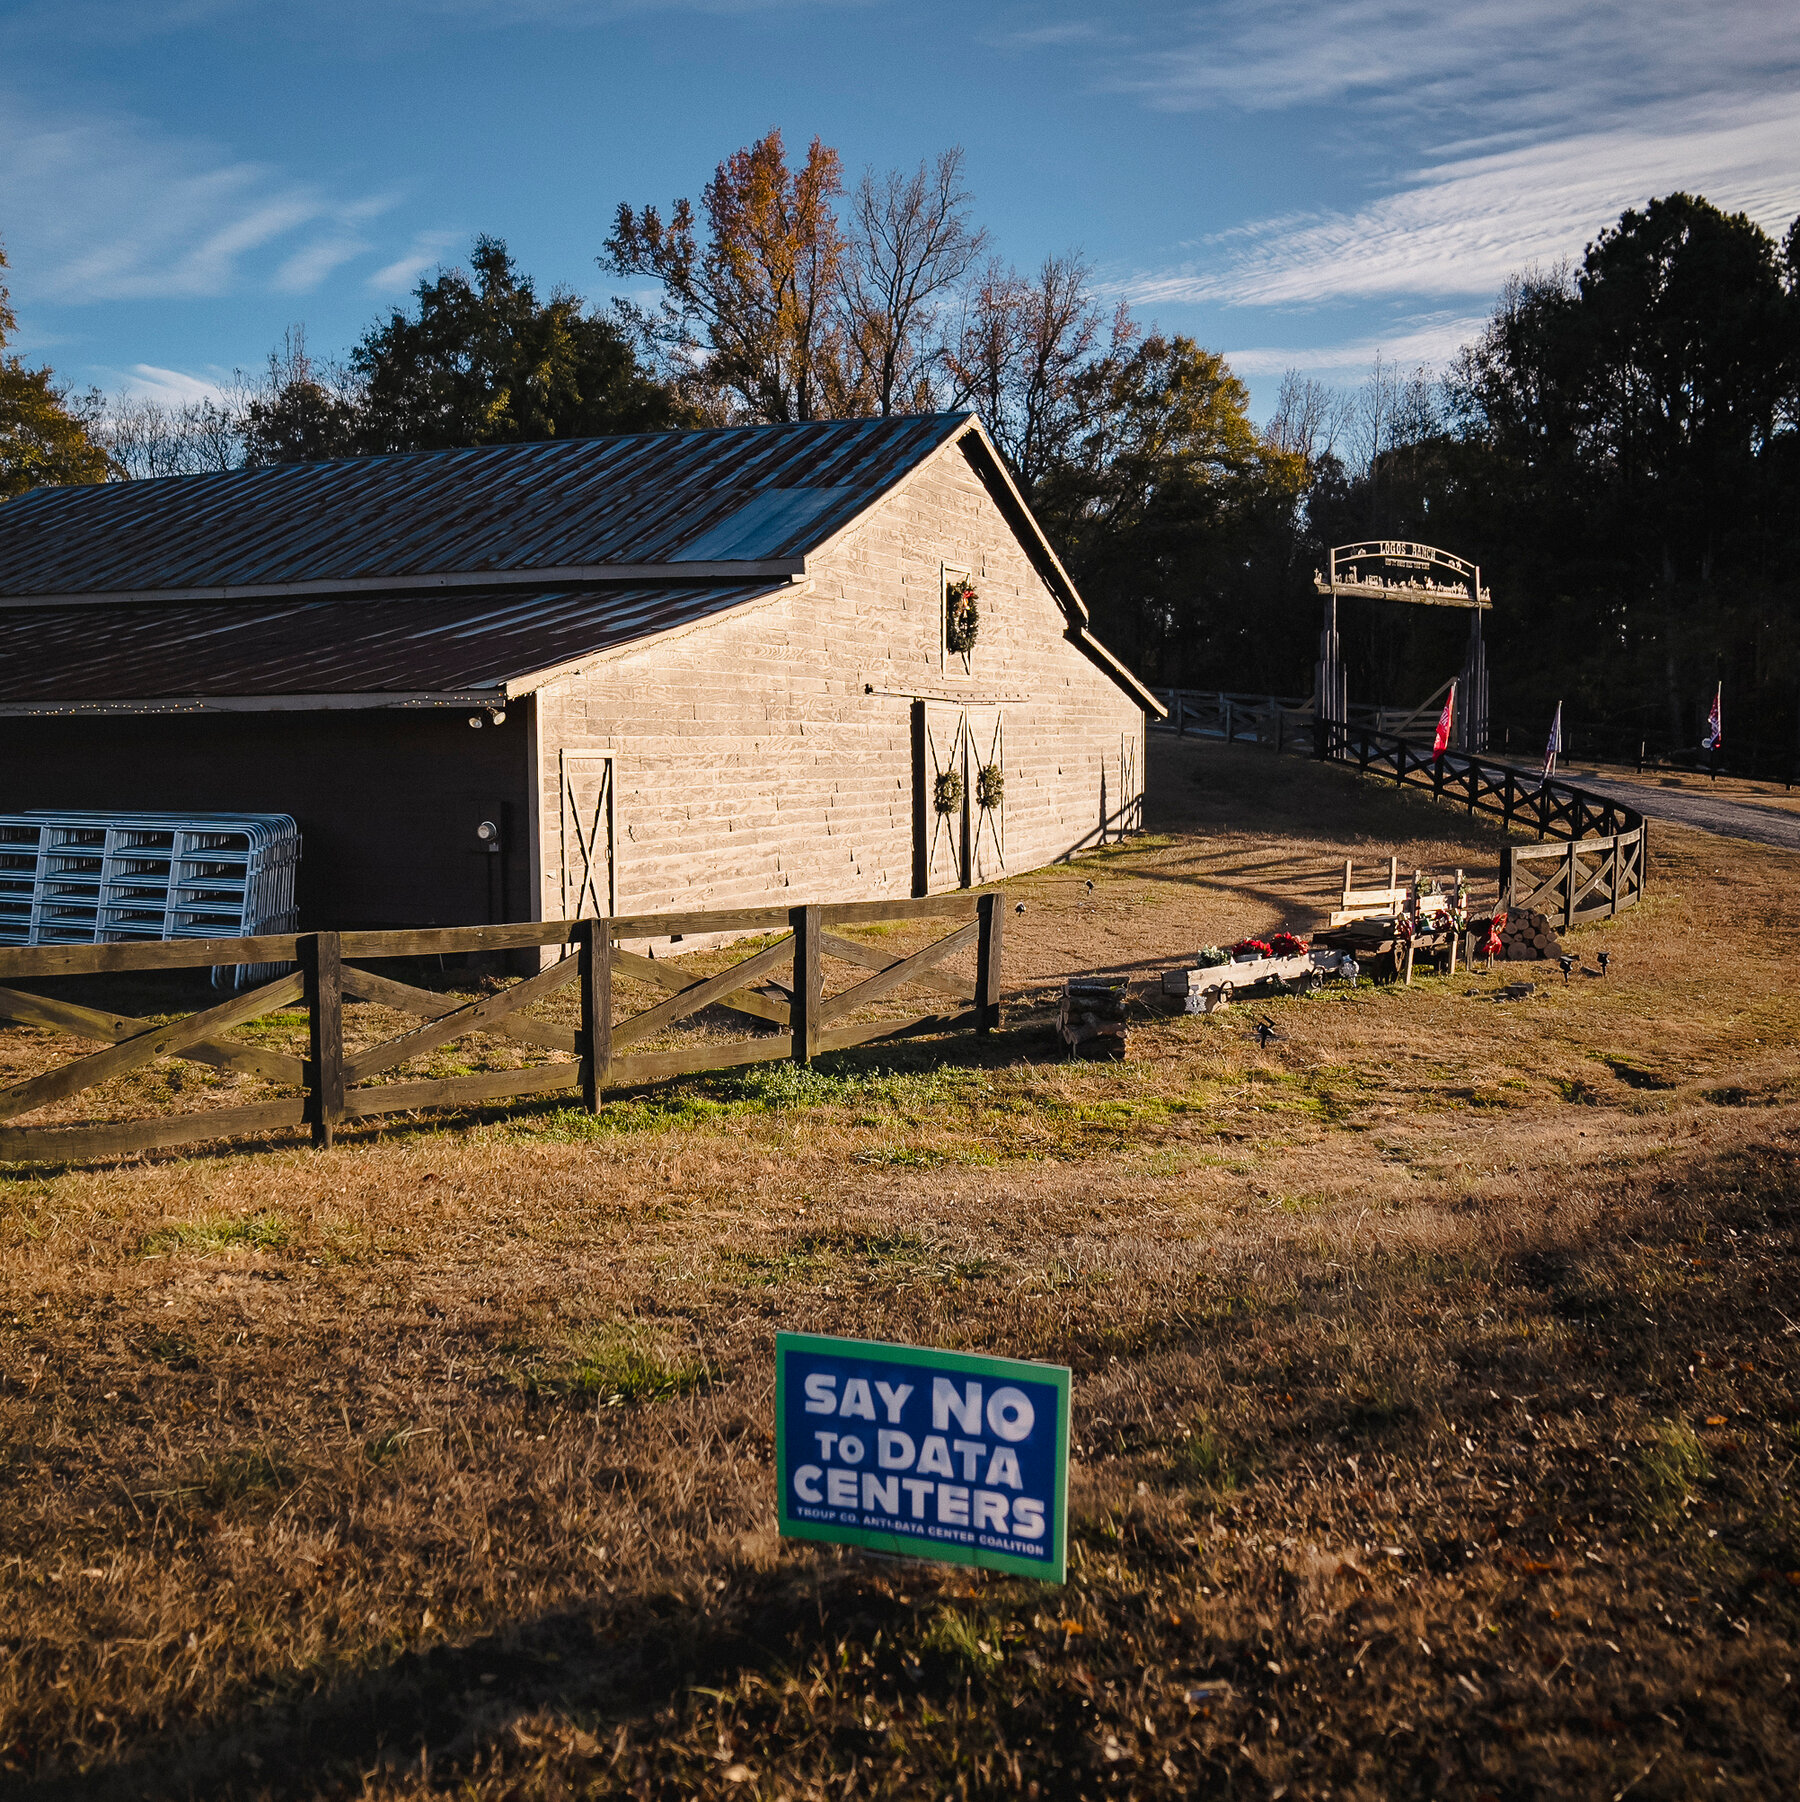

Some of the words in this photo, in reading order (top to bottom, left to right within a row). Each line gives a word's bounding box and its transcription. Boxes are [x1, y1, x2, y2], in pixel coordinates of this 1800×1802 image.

[1380, 542, 1406, 555] LOGOS
[1412, 544, 1436, 560] RANCH
[804, 1373, 914, 1424] SAY
[932, 1376, 1035, 1442] NO
[814, 1430, 865, 1464] TO
[878, 1428, 1023, 1490] DATA
[793, 1464, 1045, 1539] CENTERS
[797, 1506, 836, 1520] TROUP
[928, 1525, 975, 1543] CENTER
[979, 1534, 1044, 1556] COALITION
